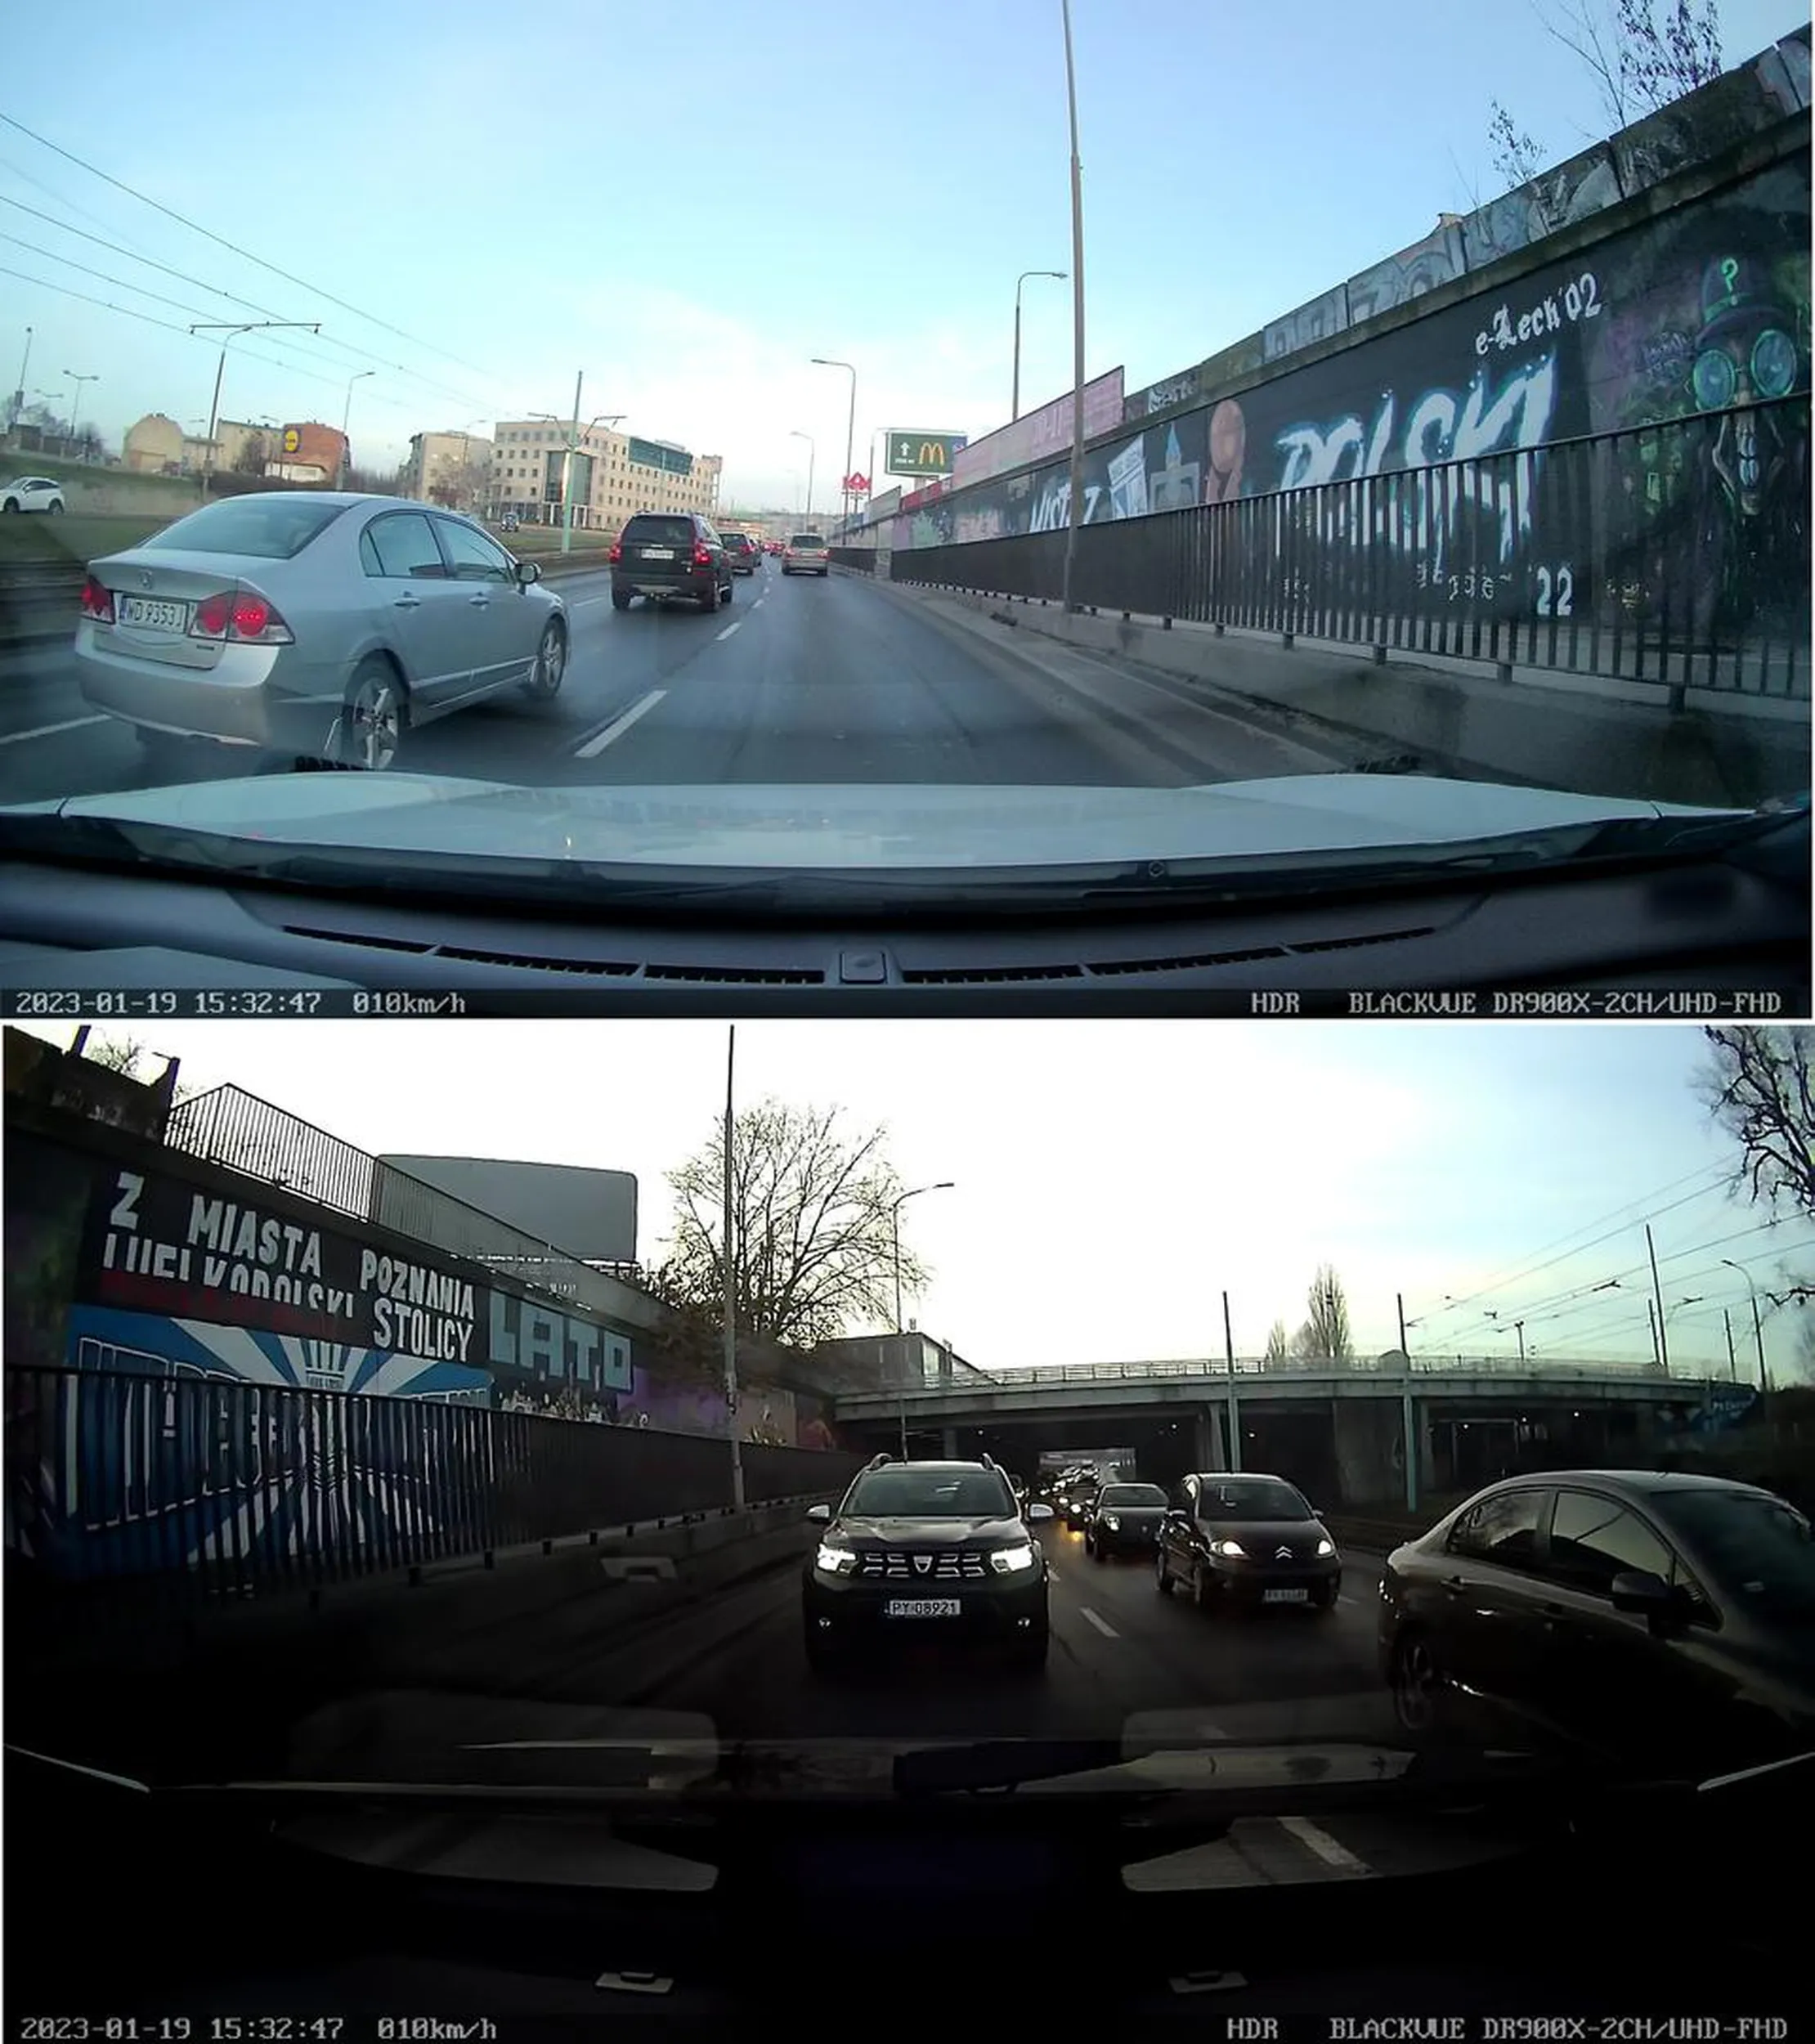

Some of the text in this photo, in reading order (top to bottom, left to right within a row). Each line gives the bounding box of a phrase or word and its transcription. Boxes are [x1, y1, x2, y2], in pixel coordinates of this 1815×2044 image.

[109, 1172, 474, 1321] Z MIASTA POZNANIA
[374, 1298, 474, 1363] STOLICY
[490, 1292, 633, 1392] LATO
